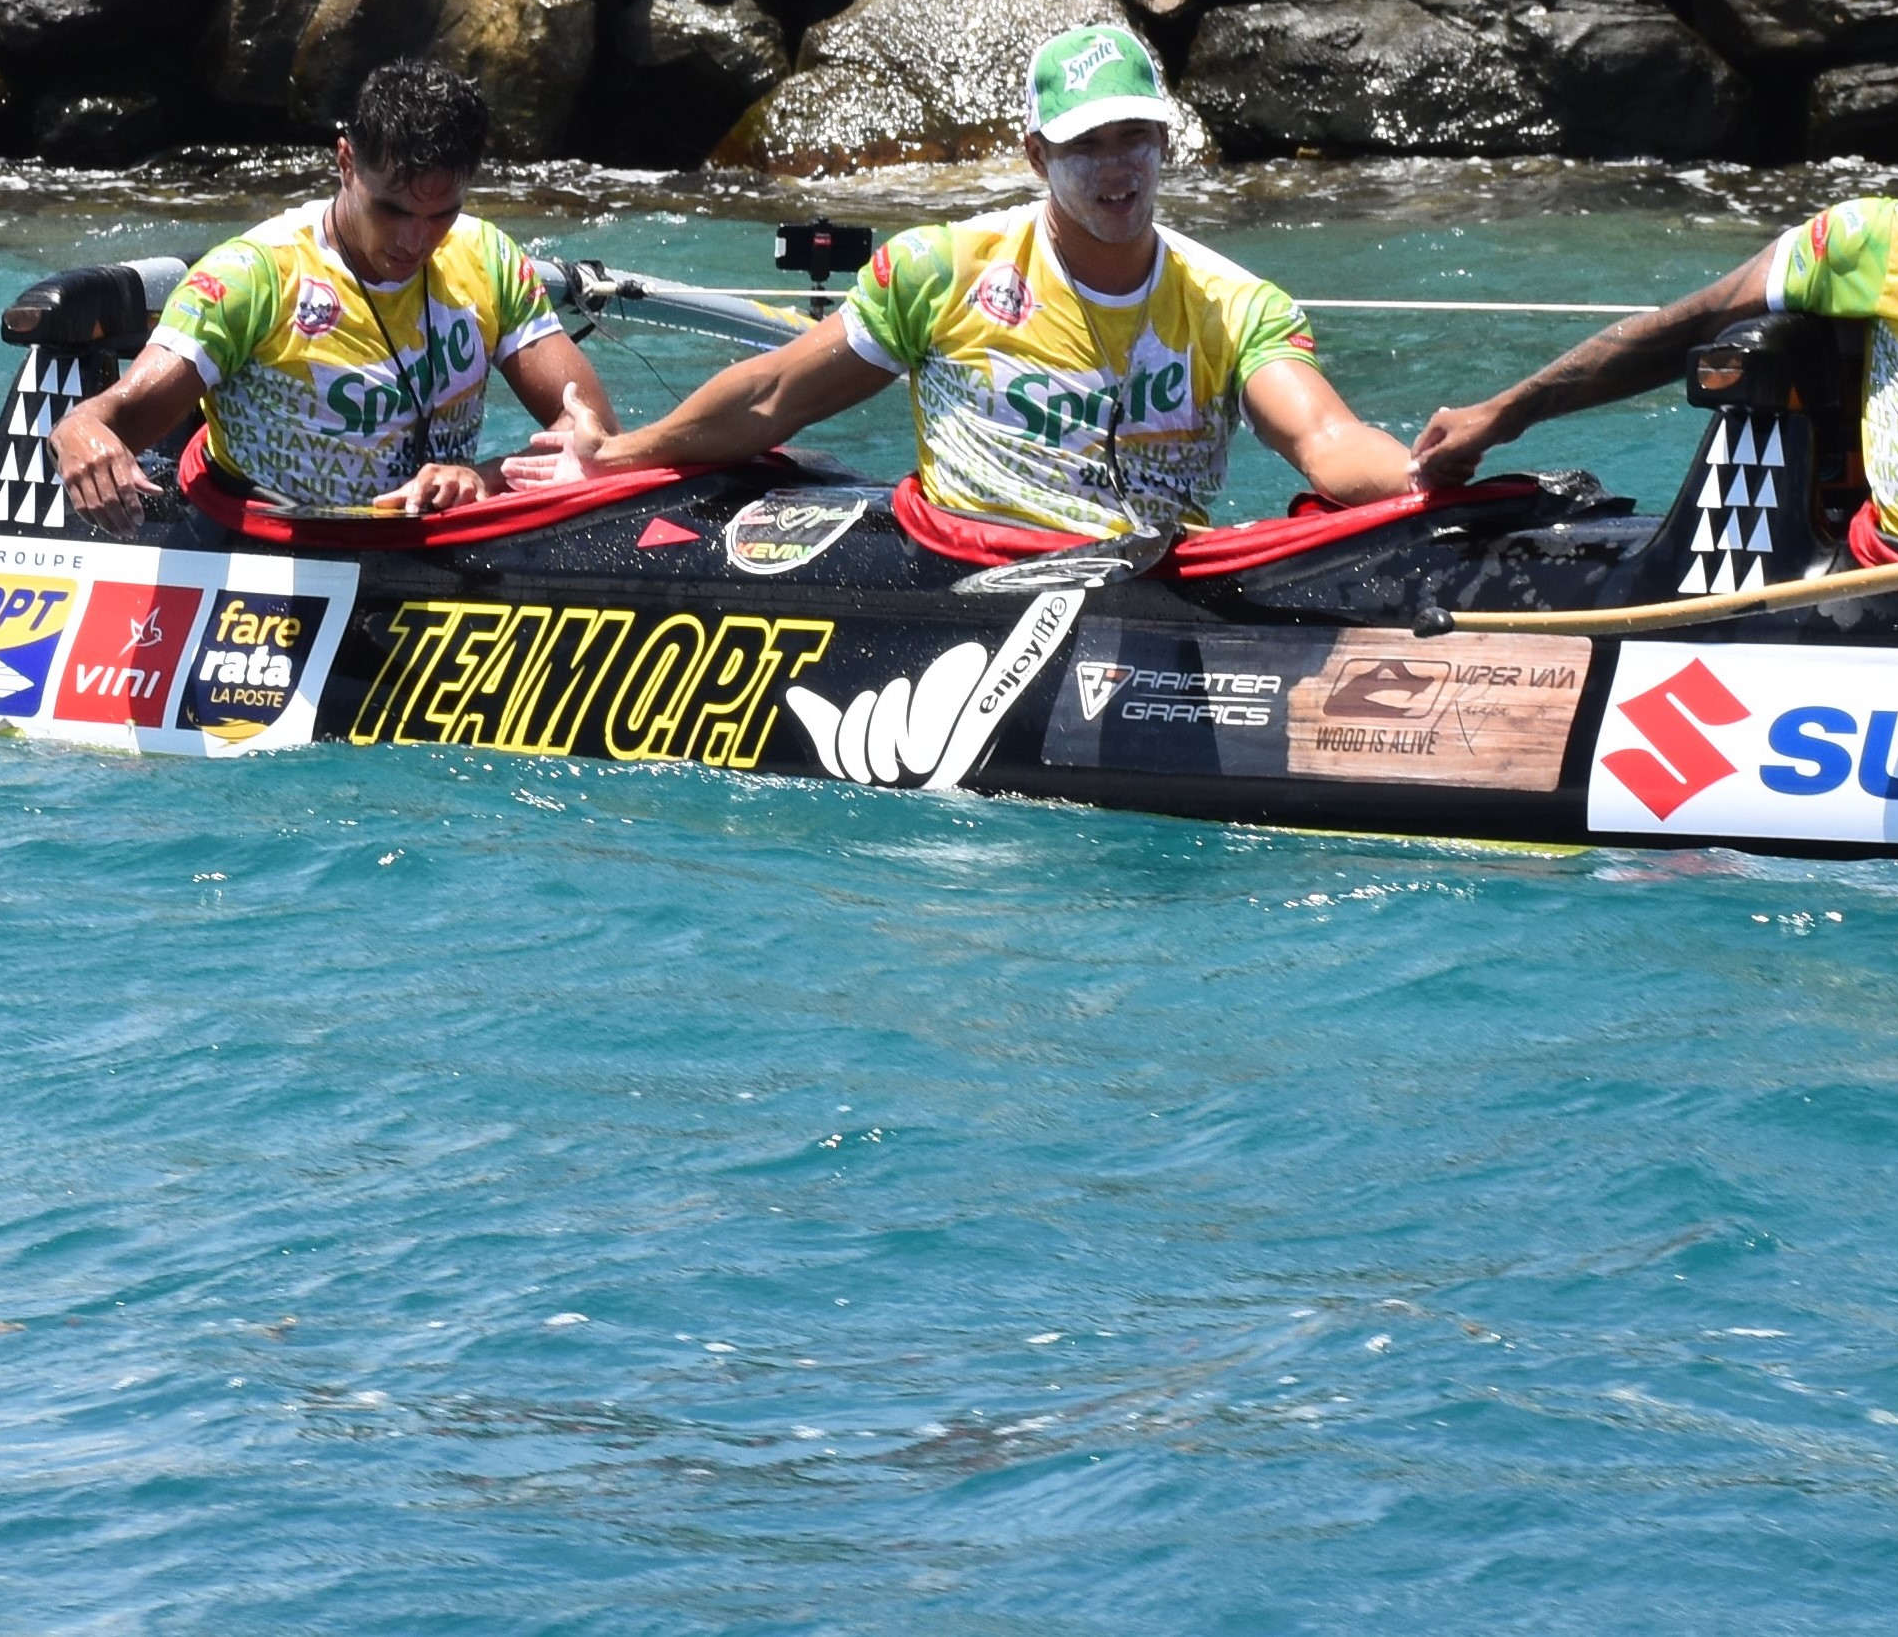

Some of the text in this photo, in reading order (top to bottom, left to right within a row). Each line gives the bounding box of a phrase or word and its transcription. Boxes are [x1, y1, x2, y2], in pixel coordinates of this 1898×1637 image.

[1066, 44, 1113, 84] Sprite
[733, 543, 814, 560] KEVIN
[216, 599, 302, 649] fare
[198, 644, 293, 689] rata
[349, 600, 636, 757] TEAM
[1455, 664, 1576, 690] VIPER VA'A
[1132, 670, 1281, 695] RAIATEA
[210, 687, 286, 709] LA POSTE
[1121, 701, 1271, 726] GRAFICS
[1315, 726, 1440, 757] WOOD IS ALIVE
